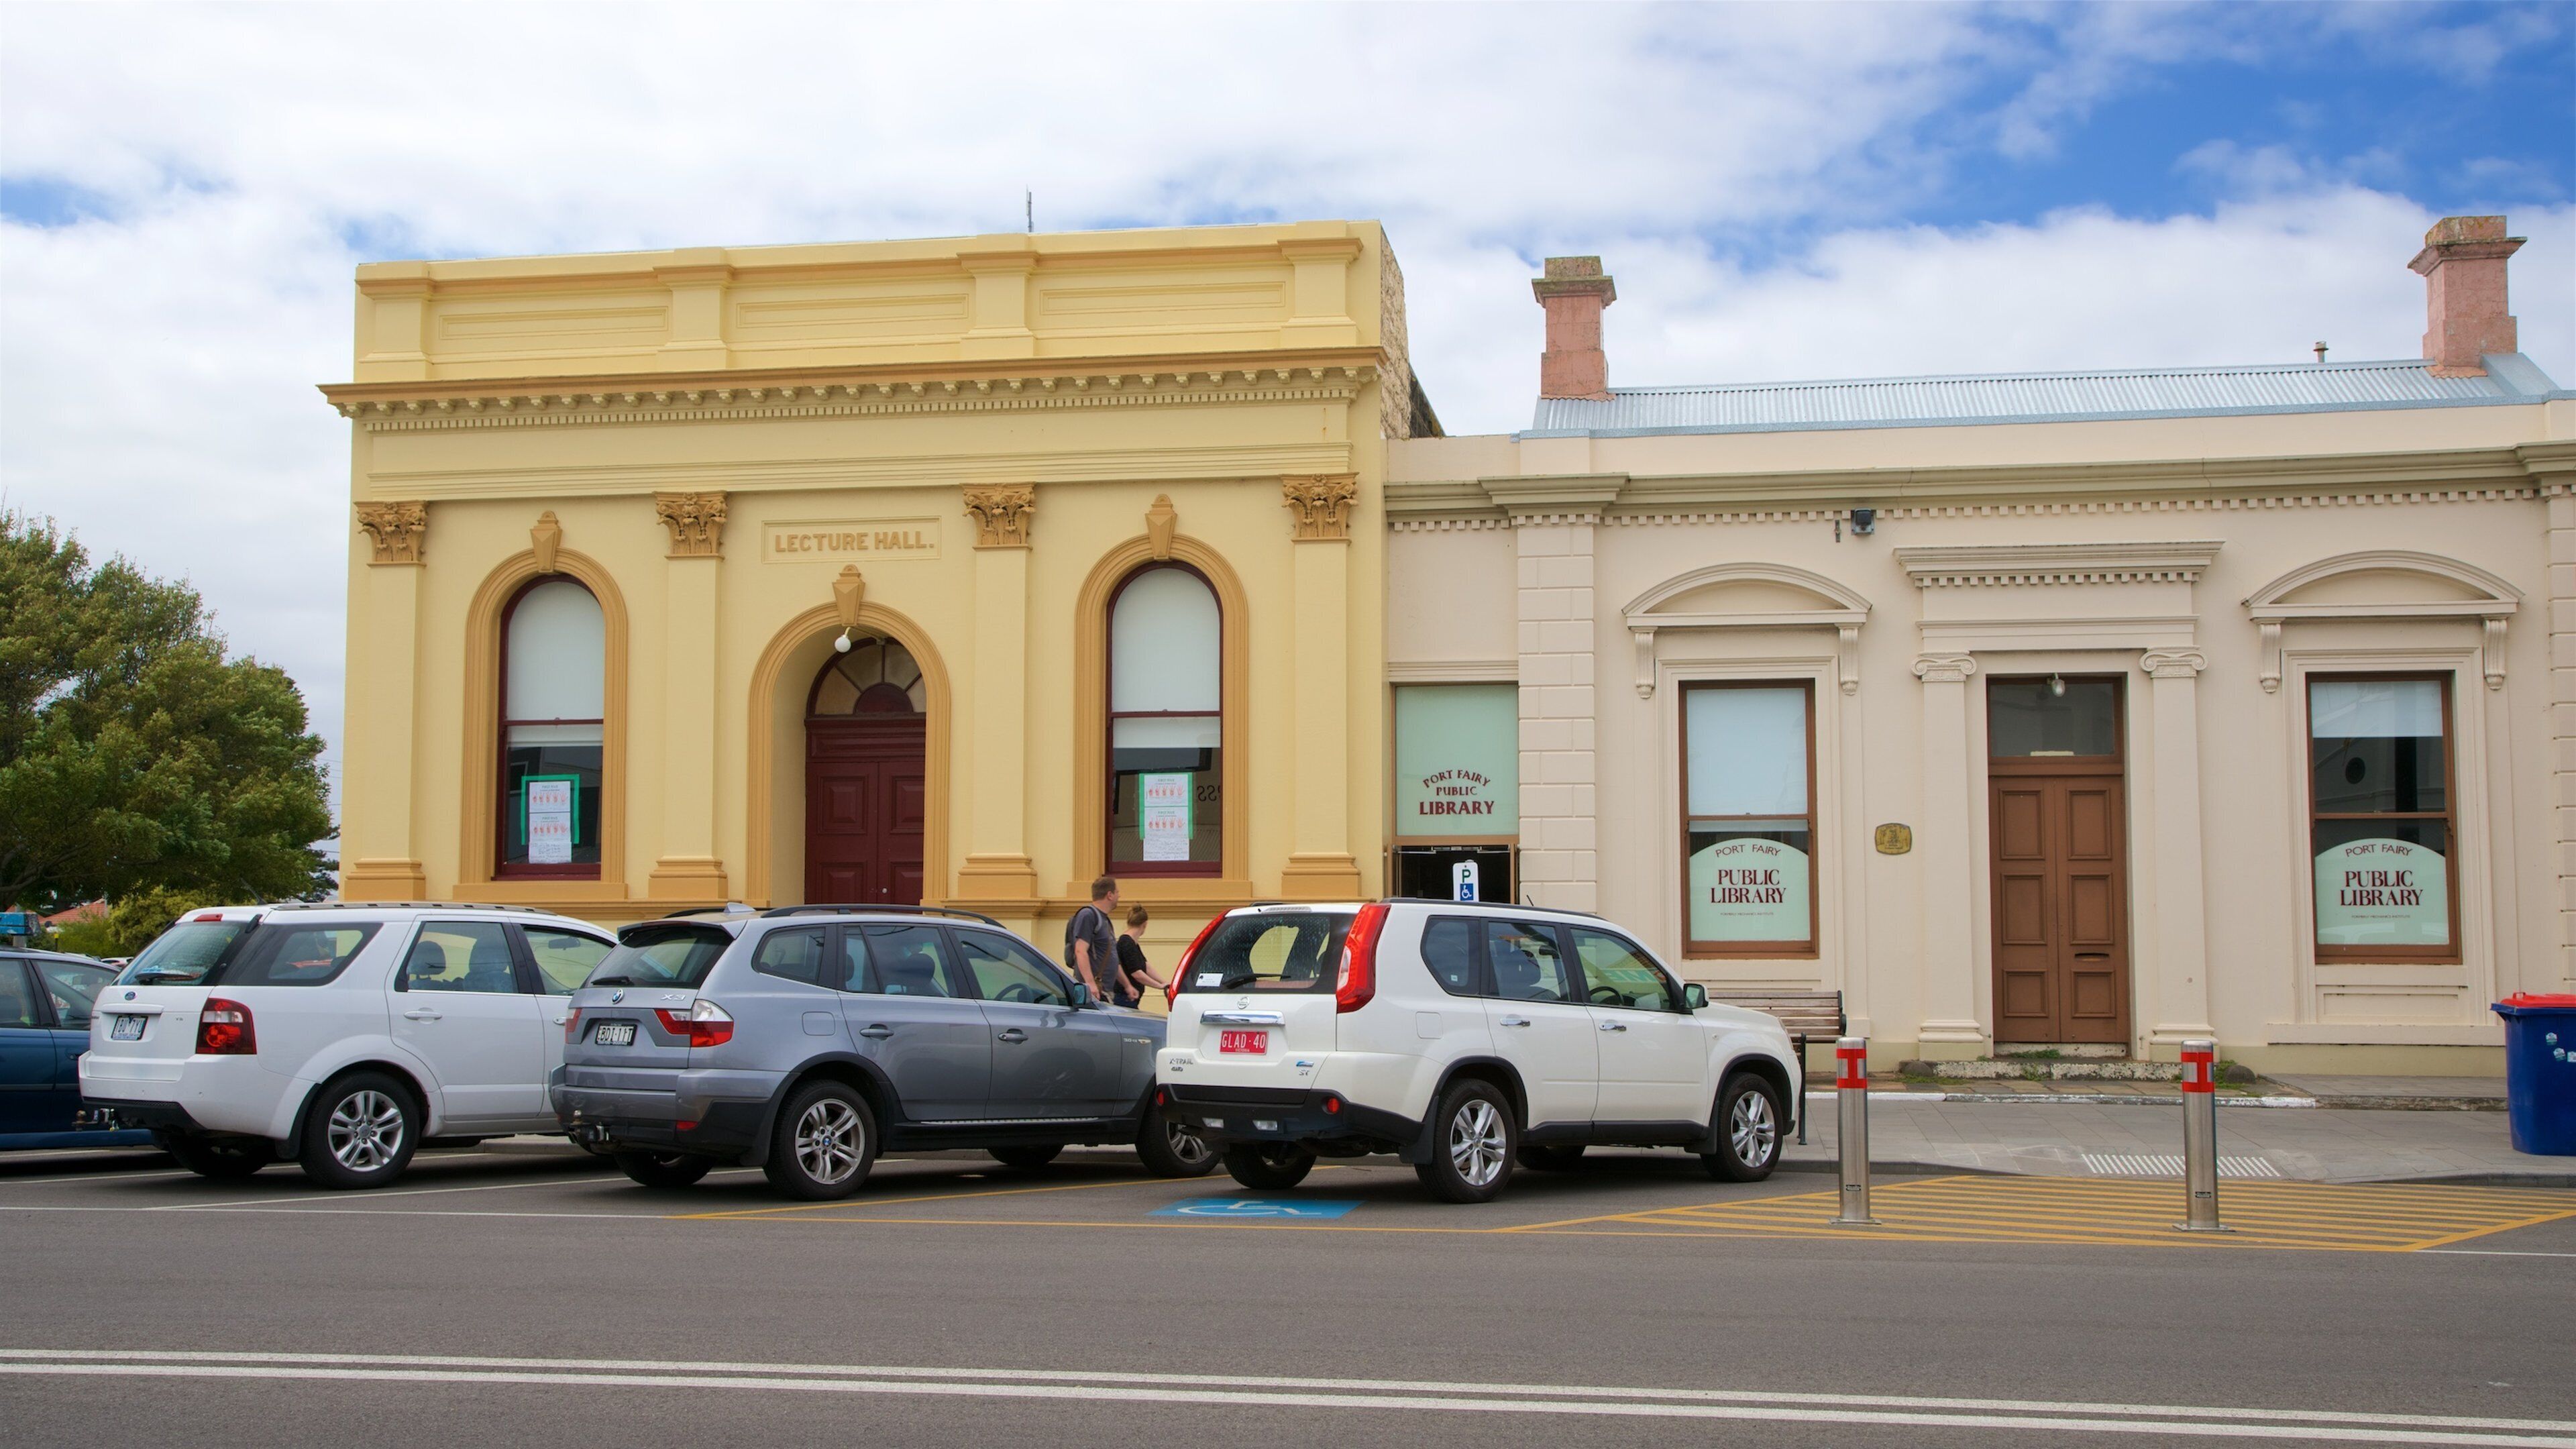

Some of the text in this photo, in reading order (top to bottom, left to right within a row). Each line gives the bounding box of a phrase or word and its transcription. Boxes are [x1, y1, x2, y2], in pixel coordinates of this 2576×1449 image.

[775, 531, 934, 552] LECTURE HALL.
[1422, 769, 1491, 788] PORT FAIRY
[1436, 786, 1477, 796] PUBLIC
[1419, 801, 1495, 815] LIBRARY
[1715, 844, 1781, 857] PORT FAIRY
[2345, 844, 2413, 857] PORT FAIRY
[1462, 869, 1471, 883] P
[1718, 869, 1780, 885] PUBLIC
[2345, 870, 2414, 888] PUBLIC
[1711, 888, 1786, 903] LIBRARY
[2340, 889, 2423, 906] LIBRARY
